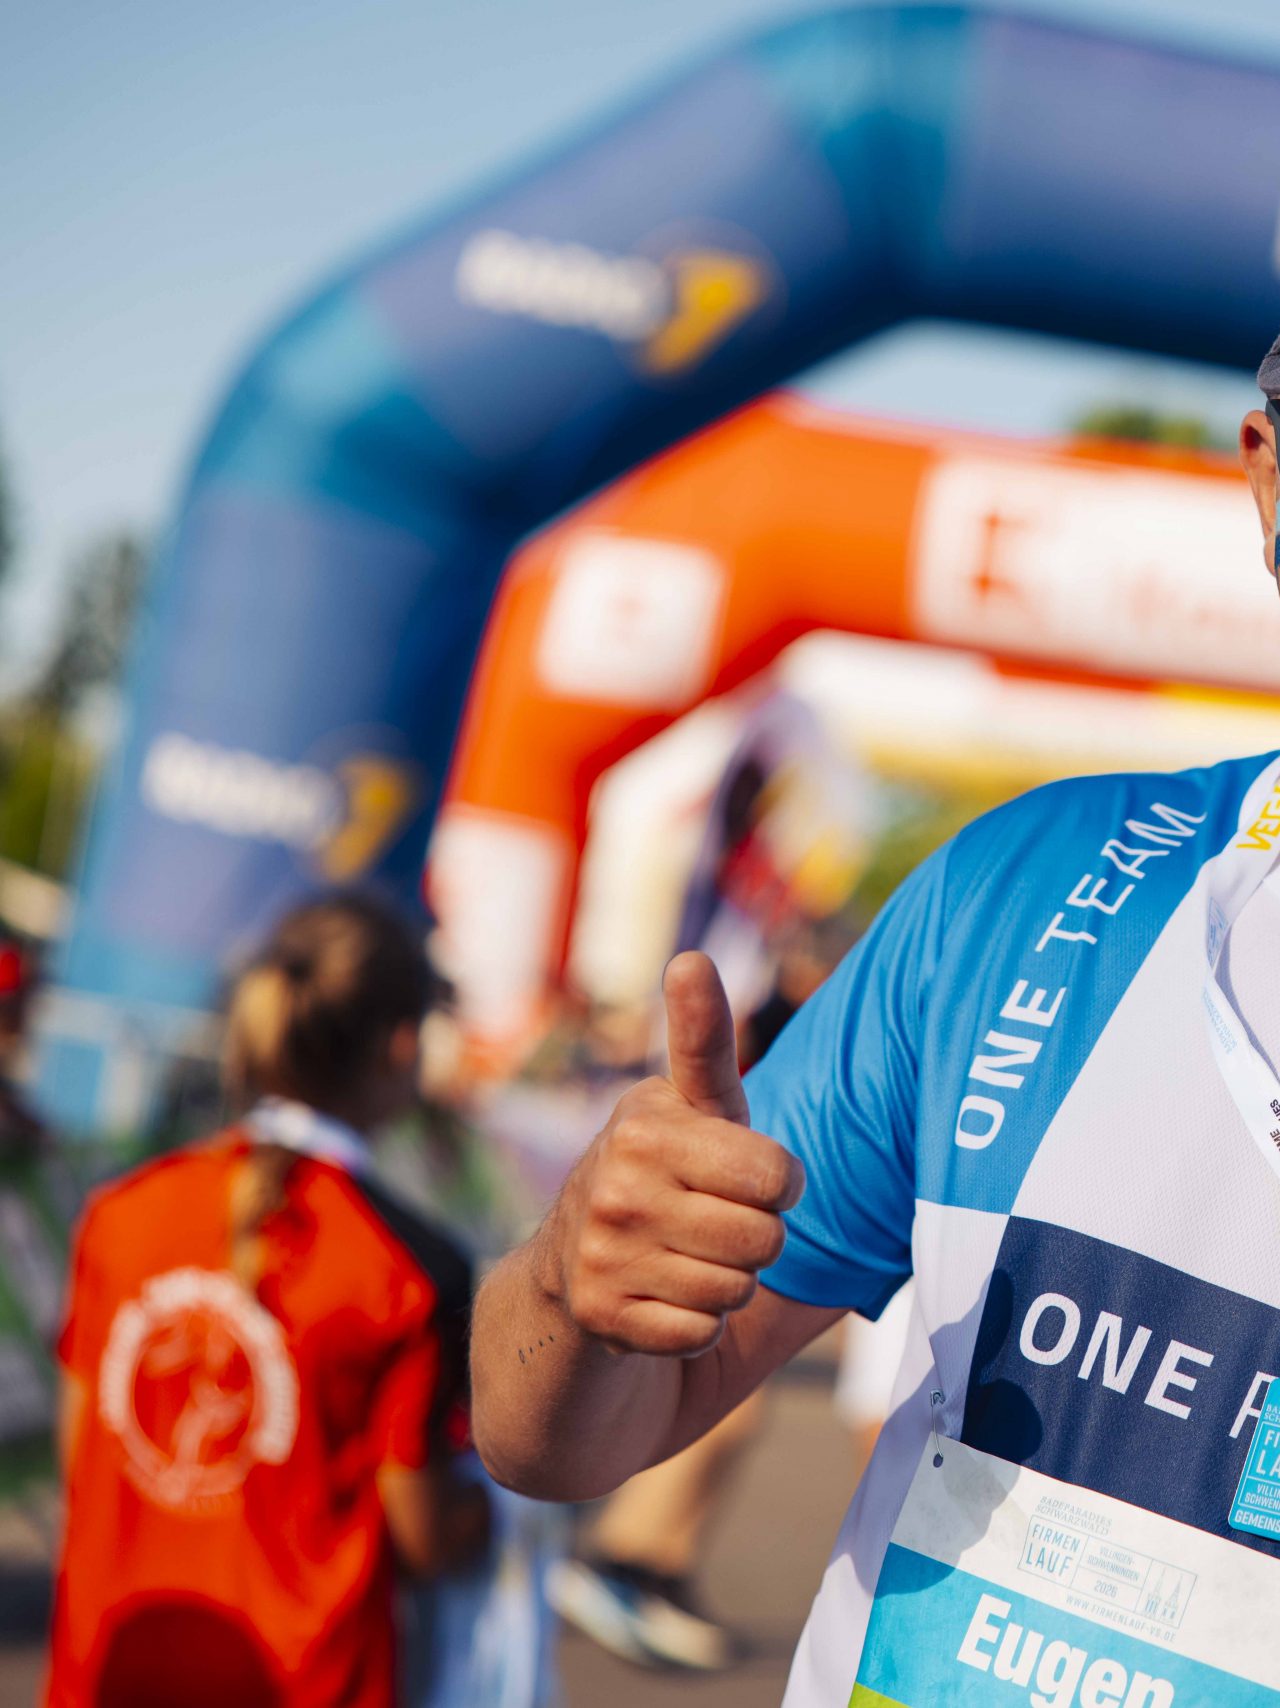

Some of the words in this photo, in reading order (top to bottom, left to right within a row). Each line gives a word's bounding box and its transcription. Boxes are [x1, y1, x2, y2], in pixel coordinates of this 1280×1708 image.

[955, 979, 1067, 1151] ONE
[1034, 802, 1208, 952] TEAM
[1018, 1292, 1215, 1420] ONE
[1034, 1504, 1110, 1536] SCHWARZWALD
[1040, 1496, 1114, 1528] BADEPARADIES
[1031, 1523, 1081, 1553] FIRMEN
[1025, 1542, 1074, 1577] LAUF
[956, 1593, 1175, 1708] Eugen
